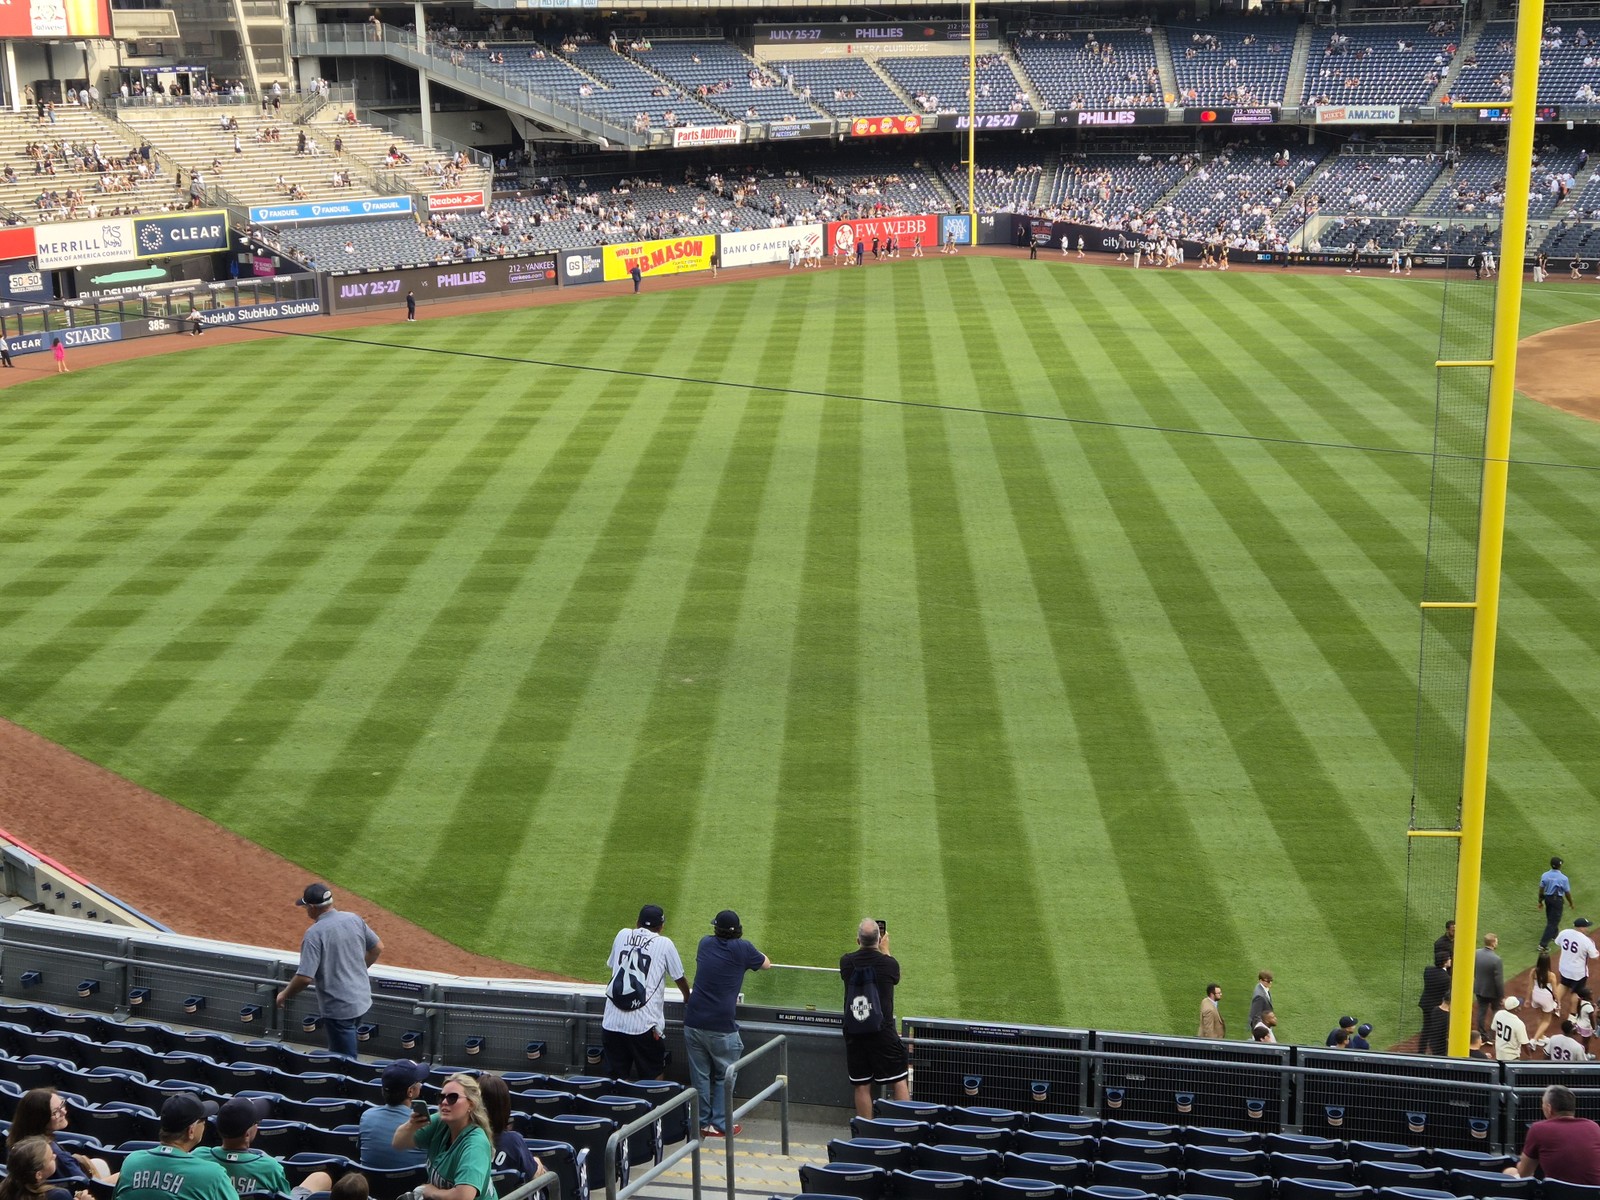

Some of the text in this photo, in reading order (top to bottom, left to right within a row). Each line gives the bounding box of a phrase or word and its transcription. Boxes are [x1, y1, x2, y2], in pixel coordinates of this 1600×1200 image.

[769, 29, 794, 40] JULY
[795, 30, 821, 39] 25-27
[855, 28, 903, 38] PHILLIES
[955, 116, 986, 128] JULY
[986, 114, 1018, 127] 25-27
[1077, 111, 1135, 125] PHILLIES
[1347, 110, 1395, 120] AMAZING
[678, 127, 737, 141] Parts Authority
[371, 202, 399, 210] FANDUEL
[430, 196, 462, 206] Reebok
[269, 209, 299, 218] FANDUEL
[321, 206, 350, 214] FANDUEL
[170, 226, 220, 240] CLEAR
[855, 219, 927, 237] F.W. WEBB
[944, 224, 967, 233] YORK
[39, 239, 100, 254] MERRILL
[723, 239, 802, 255] BANK OF AMERICA
[1102, 236, 1120, 249] city
[73, 252, 101, 260] AMERICA
[102, 249, 132, 257] COMPANY
[616, 246, 643, 257] WHO BUT
[508, 264, 521, 273] 212
[525, 261, 555, 271] YANKEES
[569, 261, 580, 270] GS
[12, 275, 39, 286] 50 50
[340, 283, 369, 298] JULY
[370, 280, 401, 295] 25-27
[437, 271, 486, 287] PHILLIES
[238, 306, 278, 320] StubHub
[281, 302, 319, 316] StubHub
[148, 319, 165, 331] 385
[65, 327, 112, 344] STARR
[11, 339, 41, 350] CLEAR
[624, 934, 654, 951] JUDGE
[1562, 938, 1579, 954] 36
[1496, 1020, 1512, 1042] 20
[1553, 1046, 1571, 1061] 33
[132, 1170, 184, 1195] BRASH
